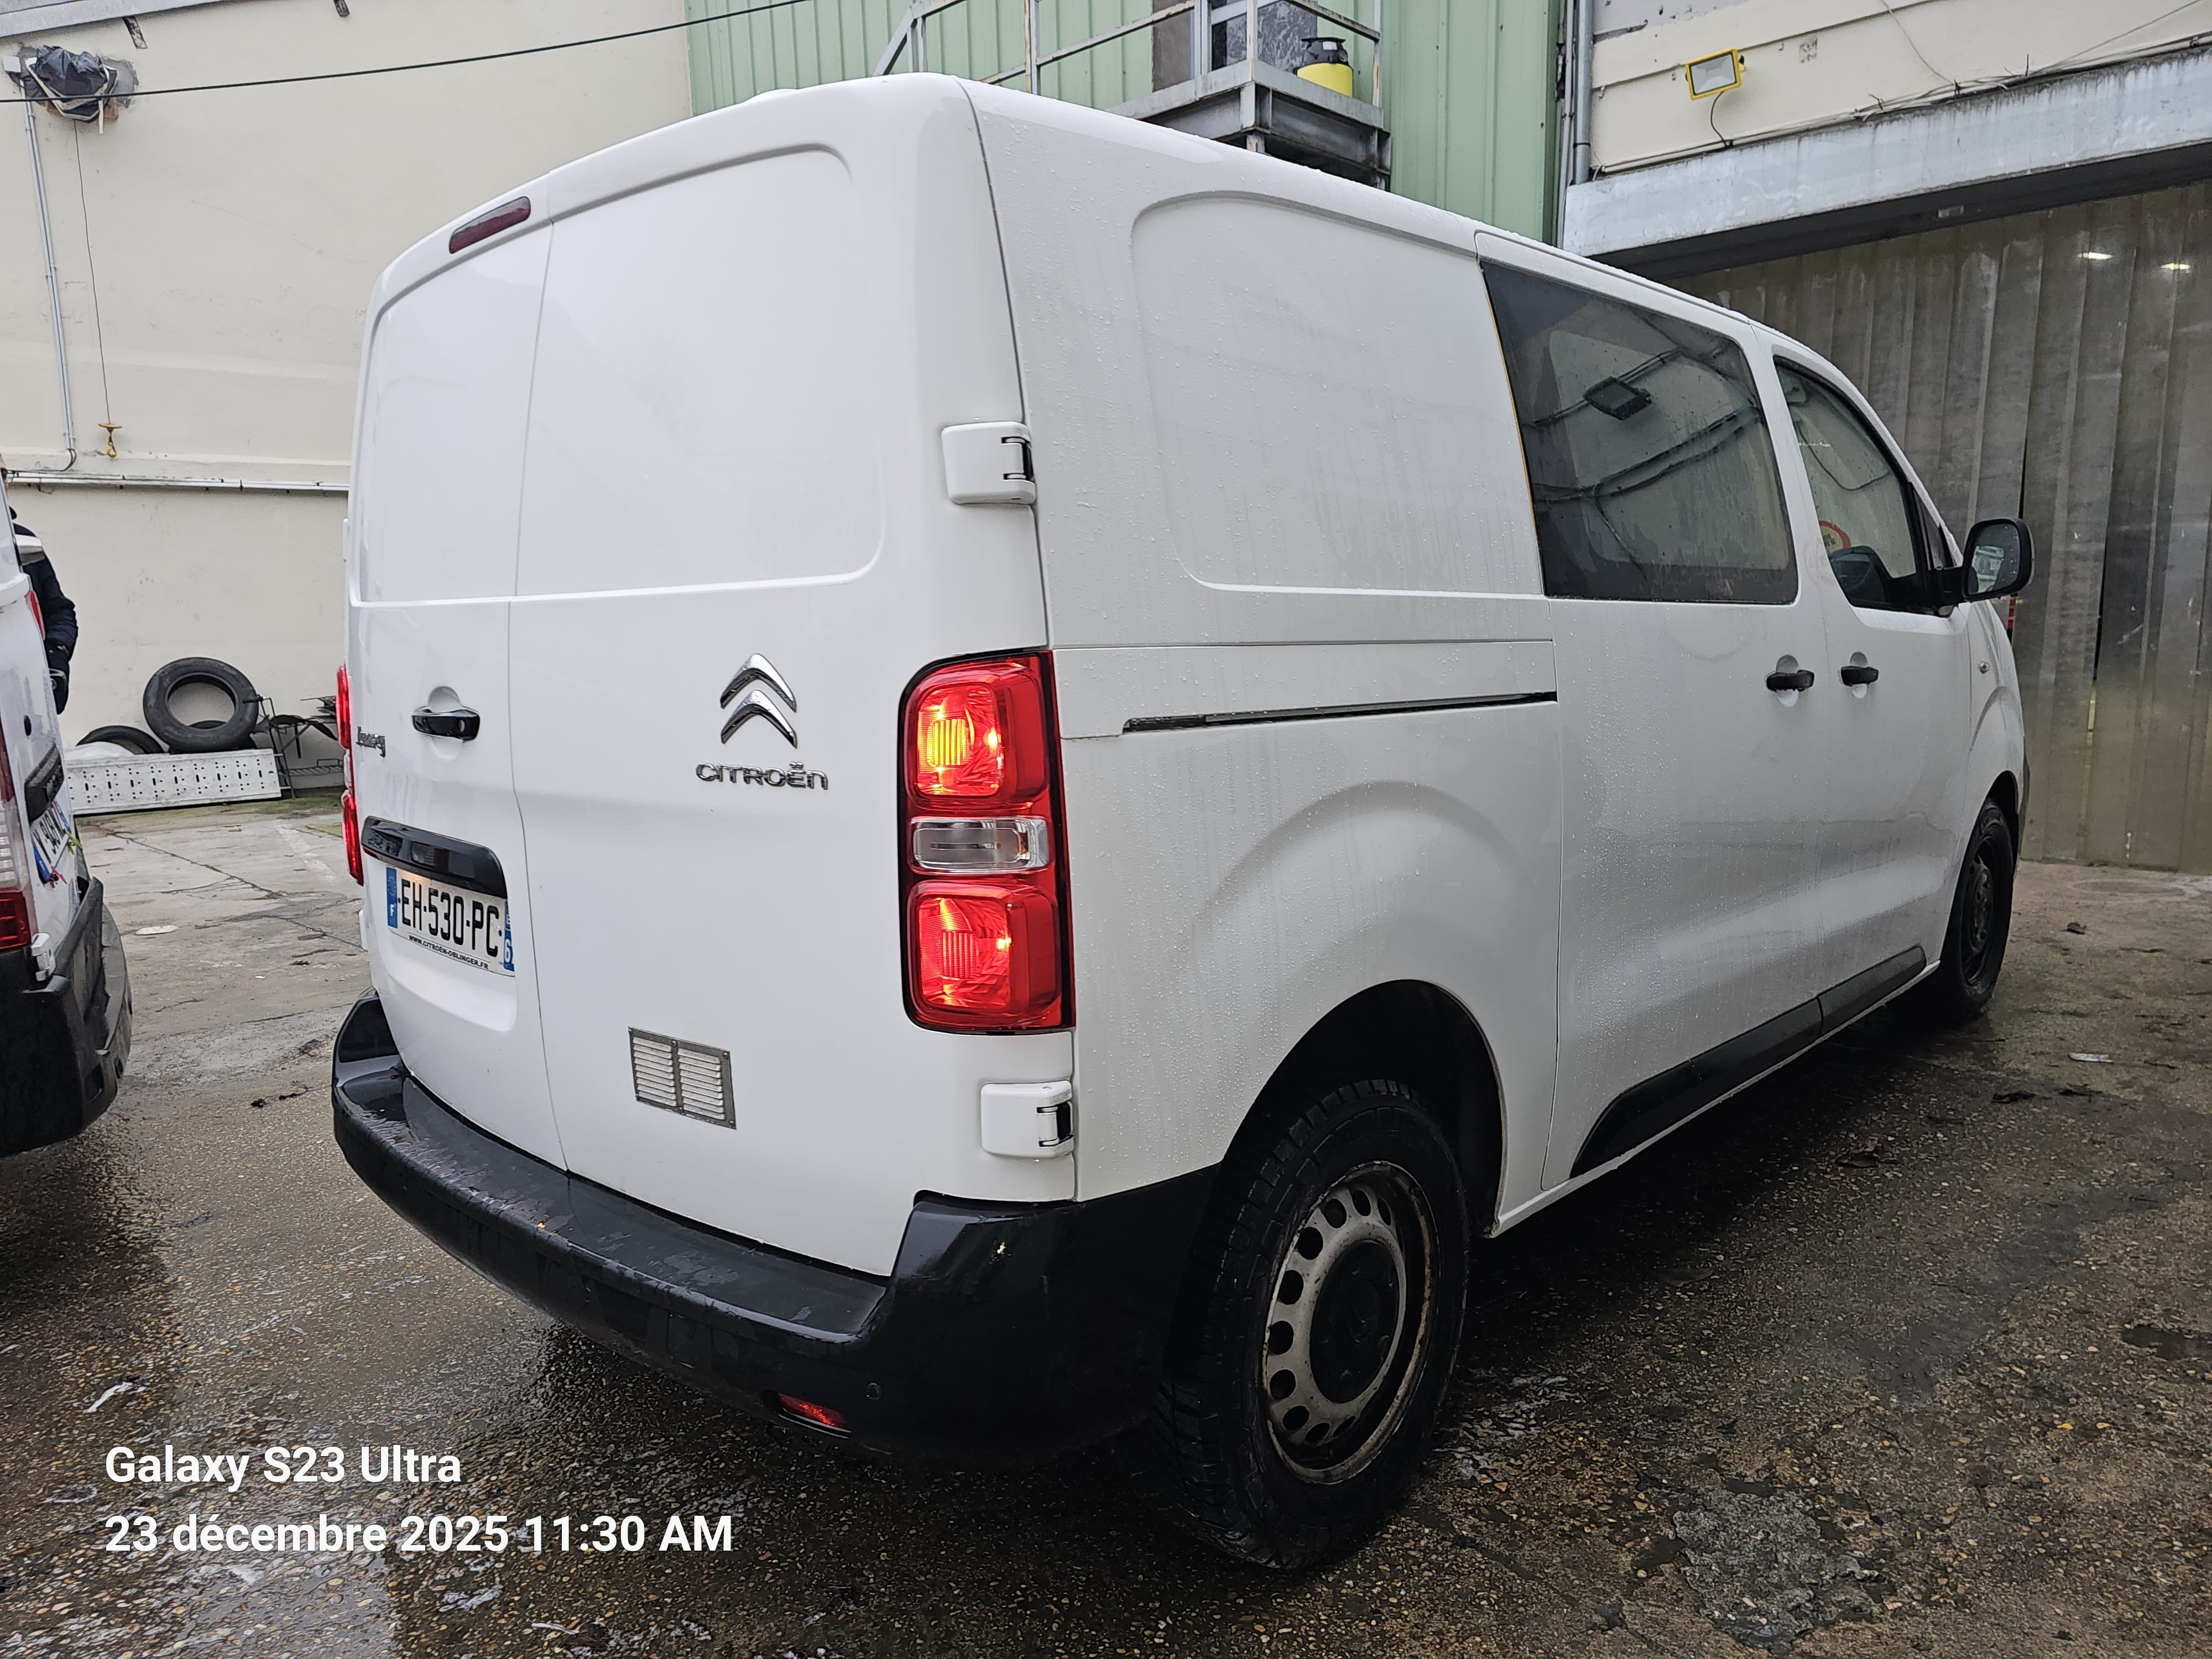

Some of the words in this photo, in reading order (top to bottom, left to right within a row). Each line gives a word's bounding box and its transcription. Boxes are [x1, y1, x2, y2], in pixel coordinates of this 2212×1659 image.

[695, 761, 828, 790] CITROËN
[390, 903, 395, 917] F
[401, 878, 499, 958] EH-530-PC
